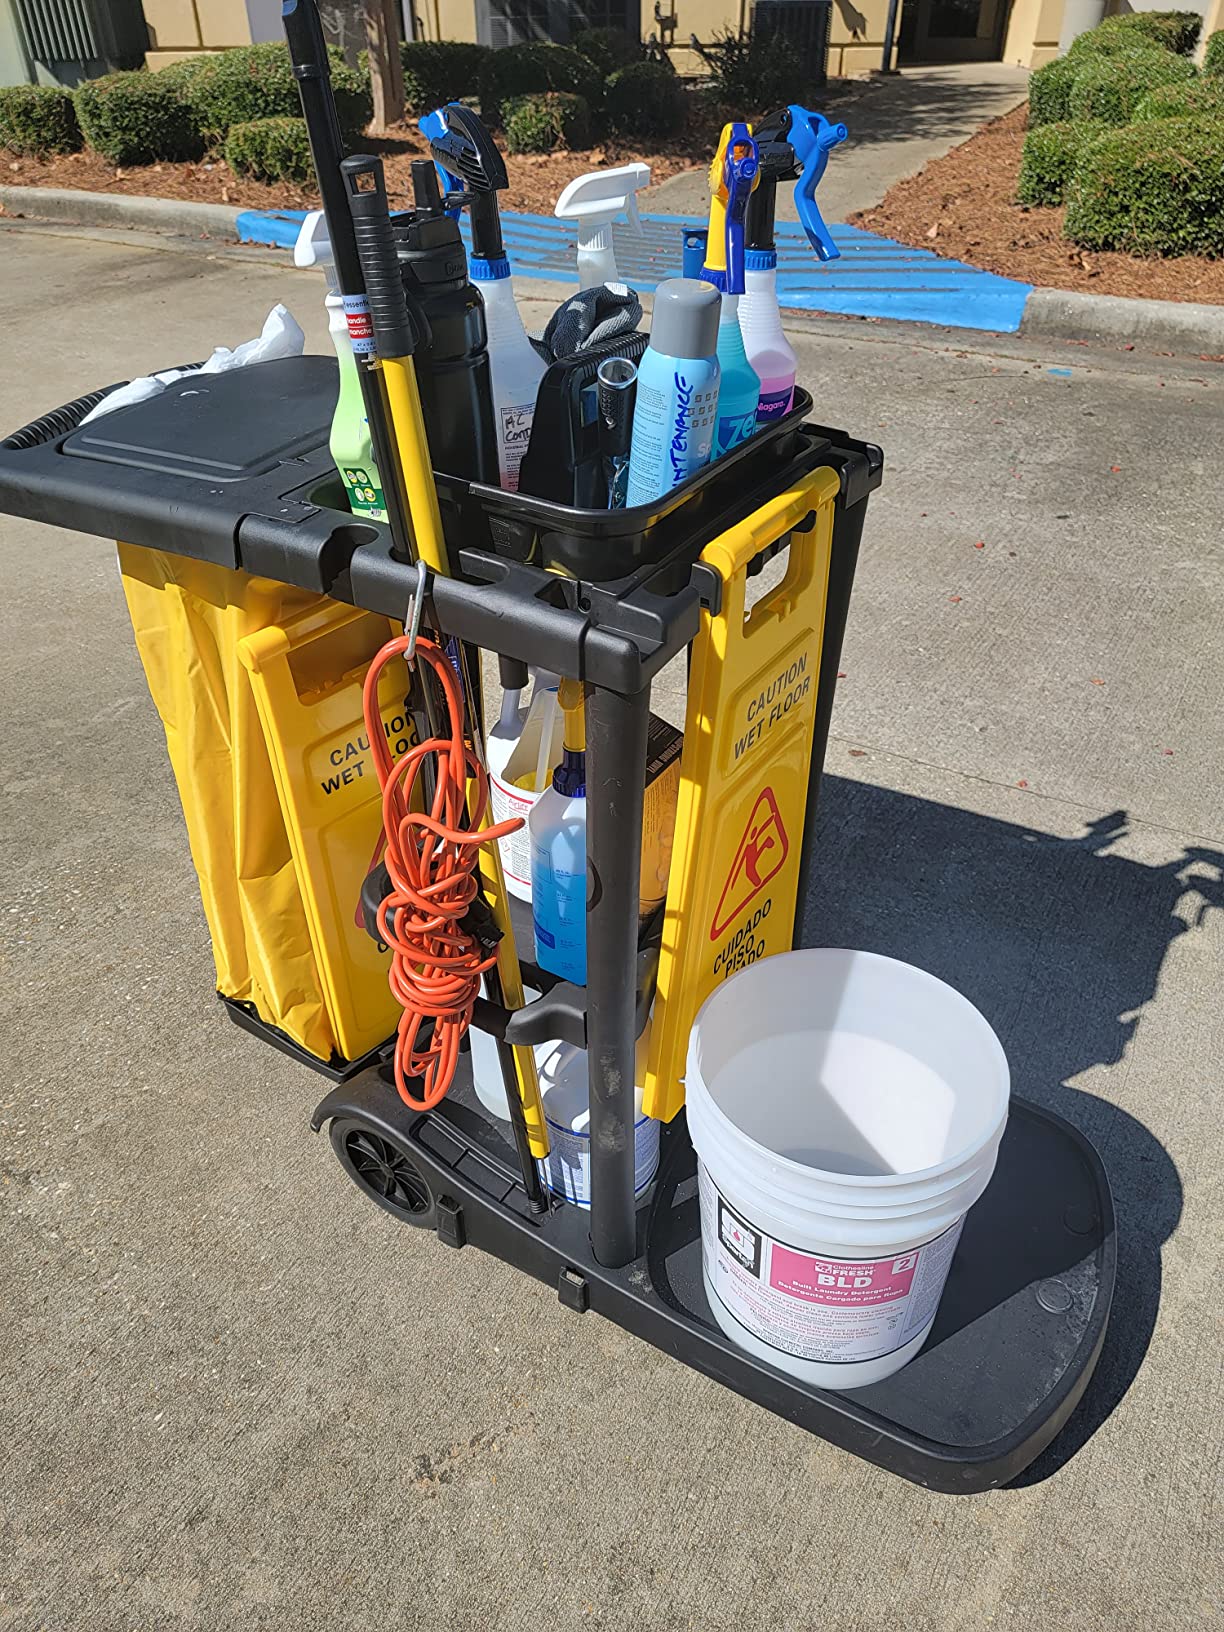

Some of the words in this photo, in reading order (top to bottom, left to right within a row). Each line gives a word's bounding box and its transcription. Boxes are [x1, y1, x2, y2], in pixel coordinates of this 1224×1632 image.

[747, 651, 808, 722] CAUTION
[735, 717, 765, 760] WET
[768, 675, 811, 728] FLOOR
[329, 711, 417, 767] CAUION
[321, 760, 365, 795] WET
[713, 898, 772, 975] CUIDADO
[725, 934, 755, 979] PISO
[817, 1273, 873, 1289] BLD
[832, 1269, 874, 1277] FRESH
[898, 1258, 911, 1271] 2
[777, 1280, 824, 1299] Detergente
[792, 1280, 812, 1290] Built
[814, 1287, 849, 1296] Laundry
[851, 1286, 892, 1296] Detergent
